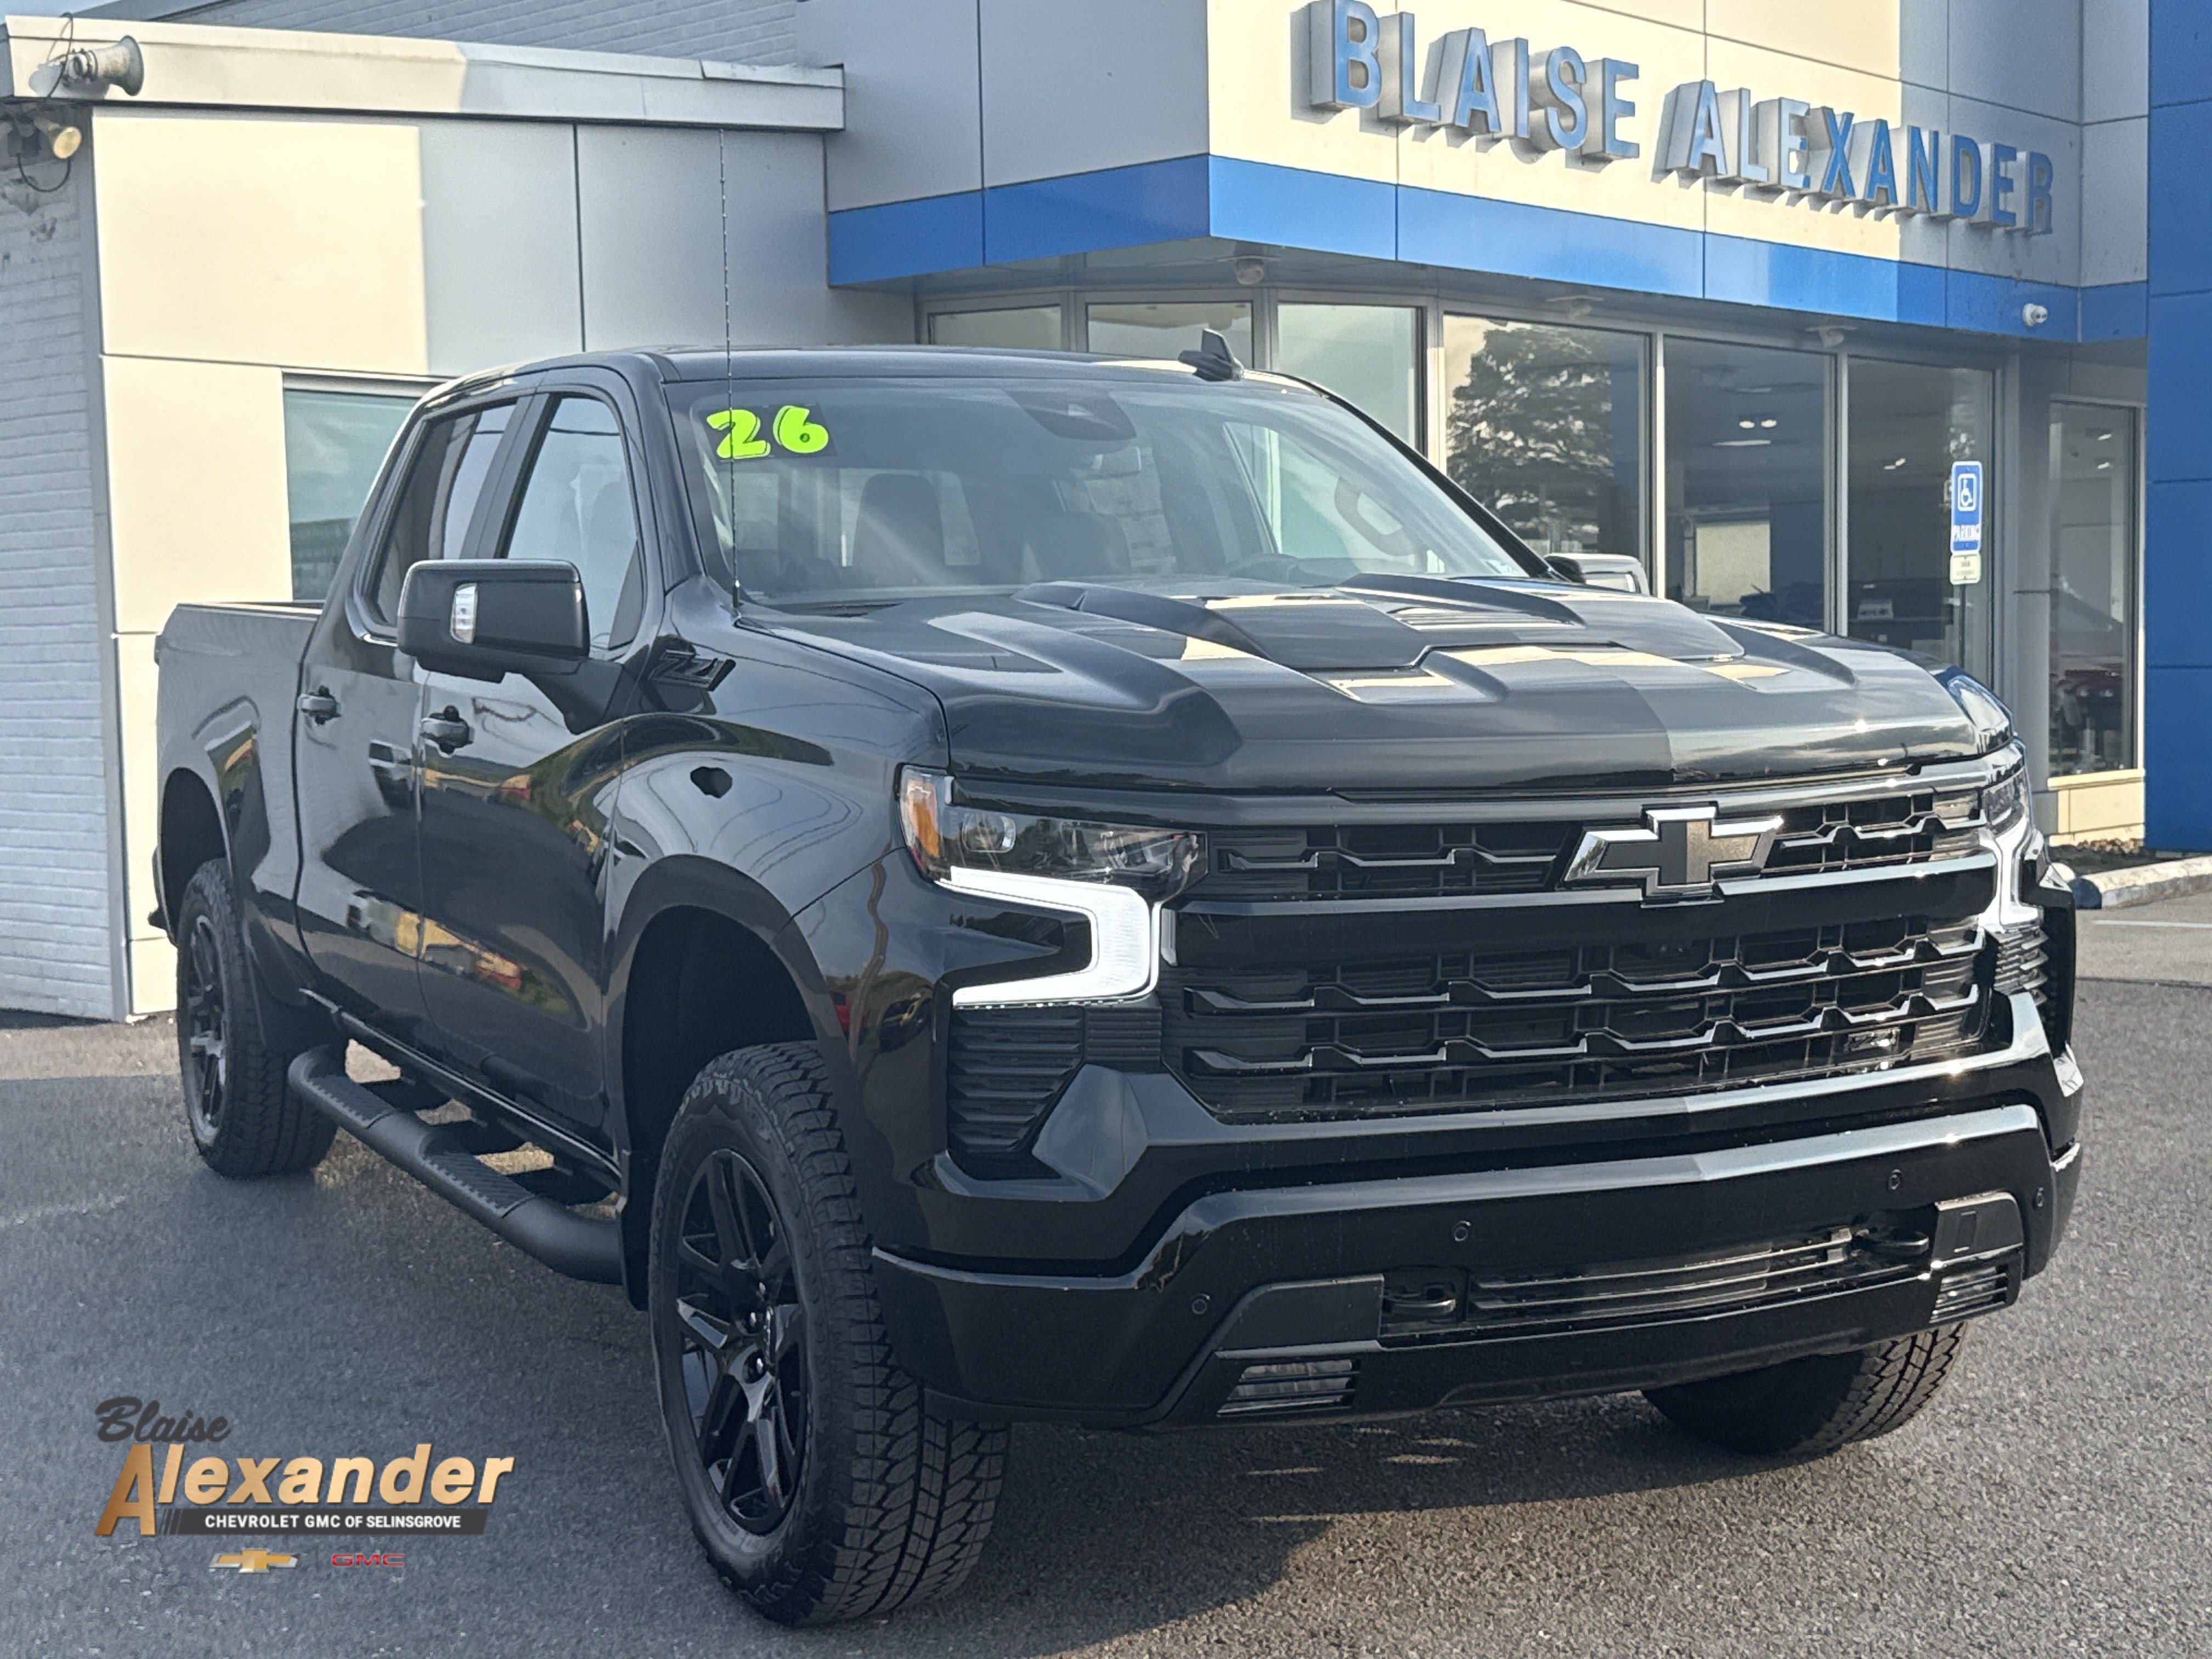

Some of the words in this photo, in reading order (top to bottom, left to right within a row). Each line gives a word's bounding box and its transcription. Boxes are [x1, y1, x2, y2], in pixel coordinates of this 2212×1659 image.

[1332, 0, 1640, 159] BLAISE
[1679, 78, 2054, 235] ALEXANDER
[706, 405, 830, 459] 26
